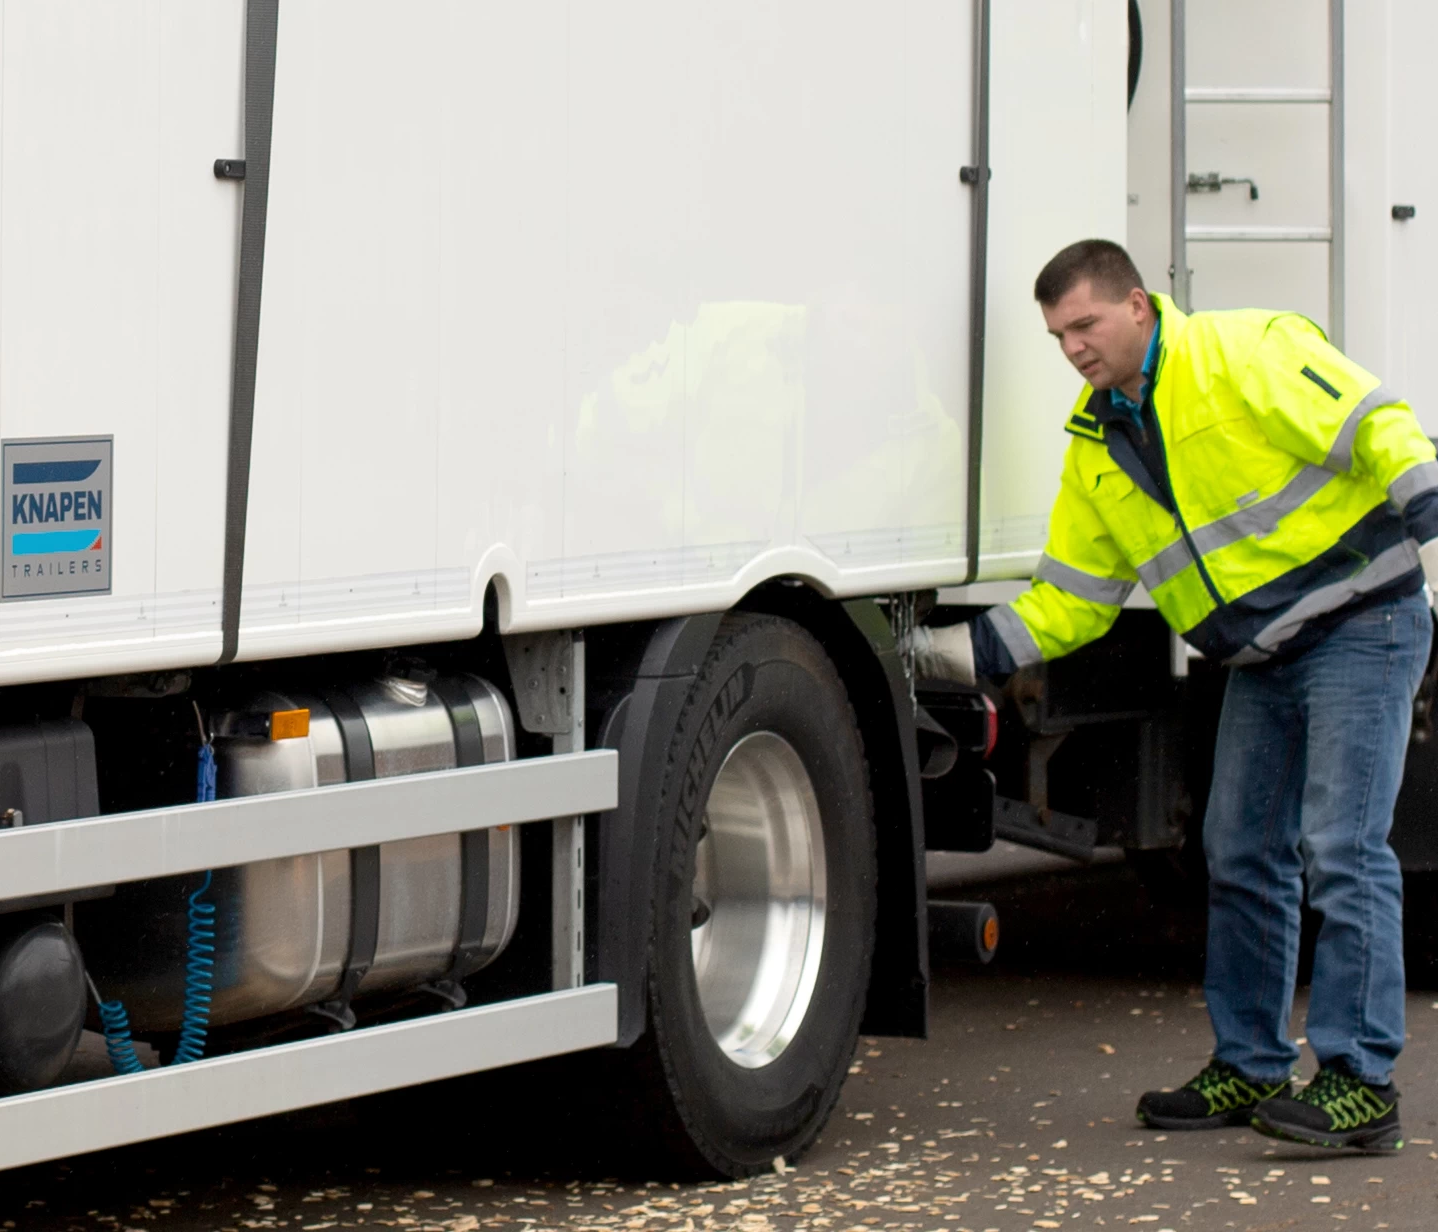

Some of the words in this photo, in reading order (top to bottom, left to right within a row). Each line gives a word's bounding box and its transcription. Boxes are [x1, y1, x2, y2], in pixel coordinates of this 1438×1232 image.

[12, 489, 103, 525] KNAPEN
[11, 558, 103, 578] TRAILERS
[669, 666, 745, 880] MICHELIN
